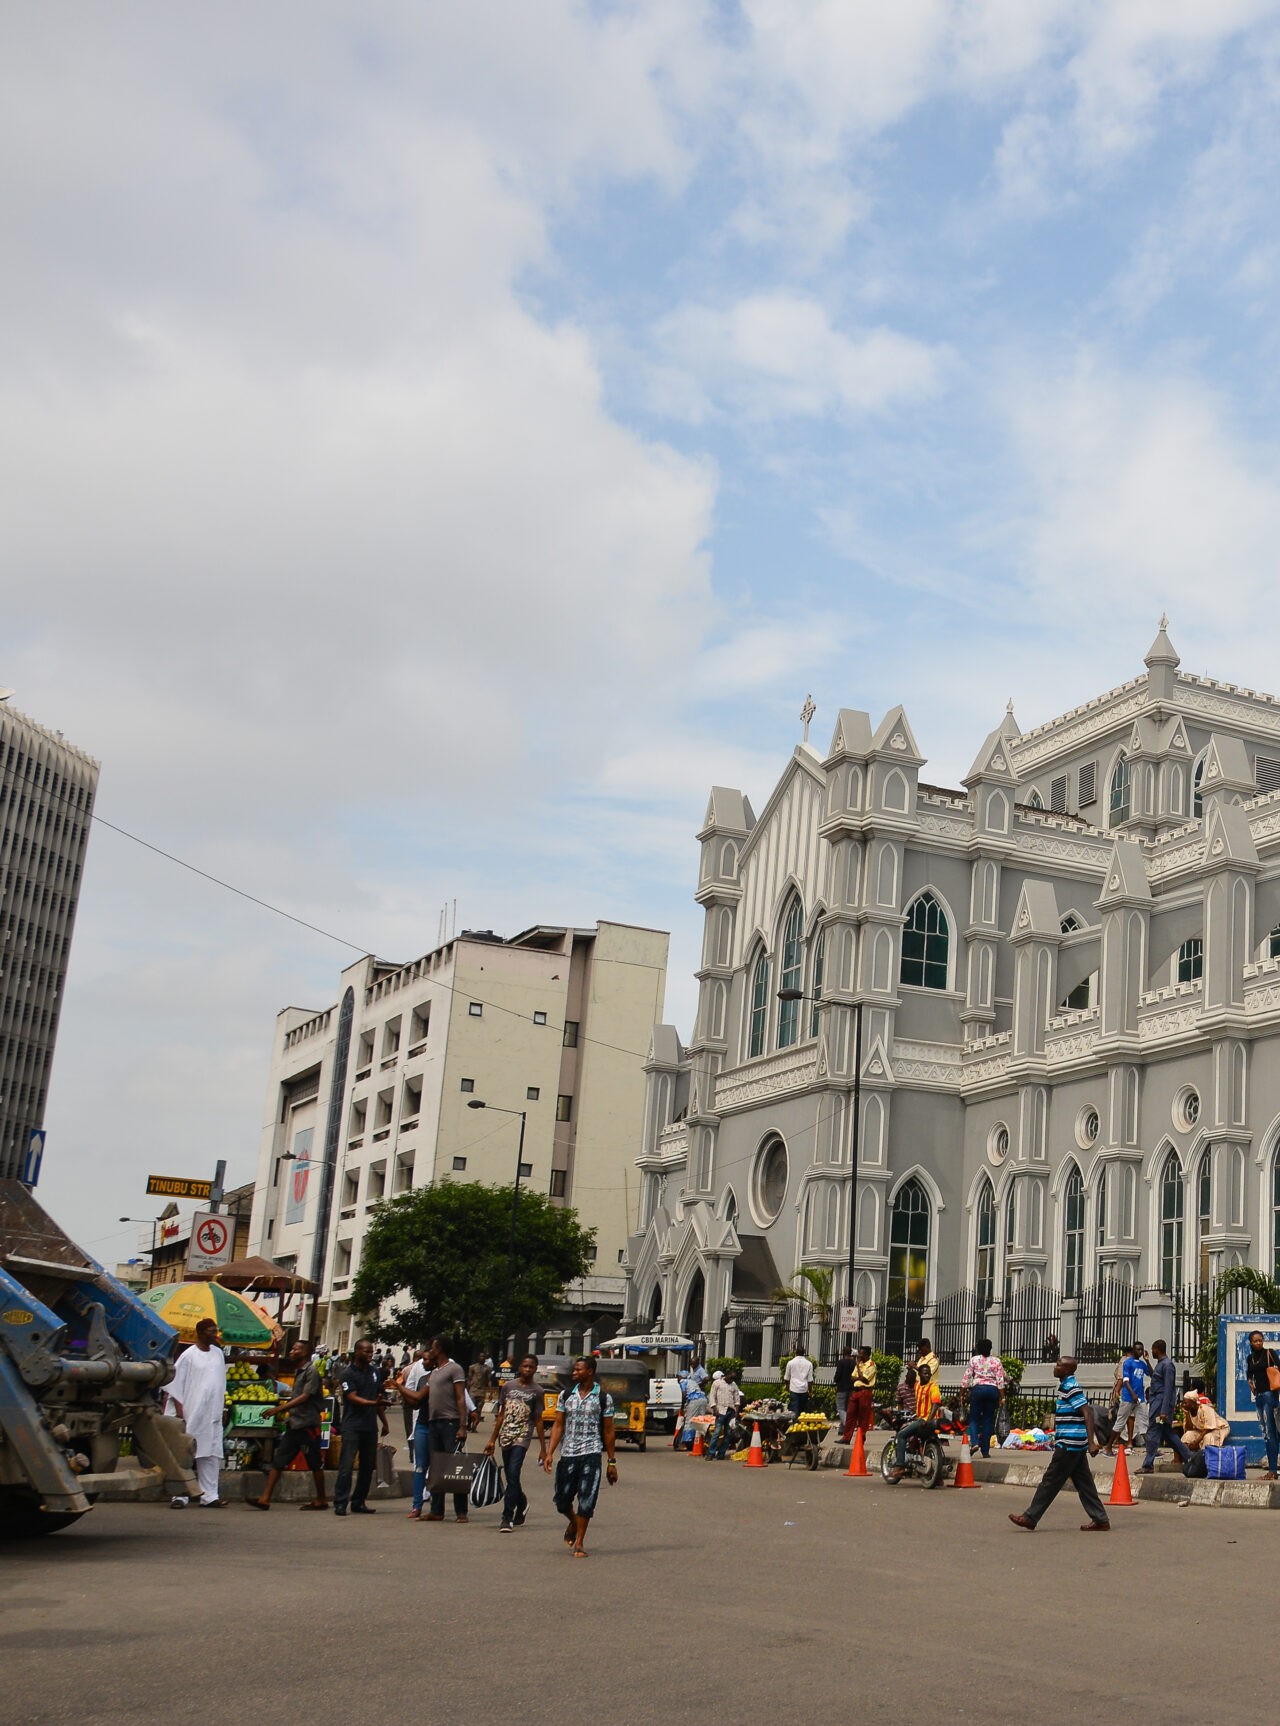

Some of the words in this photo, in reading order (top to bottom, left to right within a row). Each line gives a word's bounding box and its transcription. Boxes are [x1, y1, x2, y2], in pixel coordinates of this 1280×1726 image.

[149, 1179, 188, 1194] TINUBU
[189, 1183, 210, 1197] STR
[640, 1336, 654, 1344] CBD
[654, 1336, 679, 1344] MARINA
